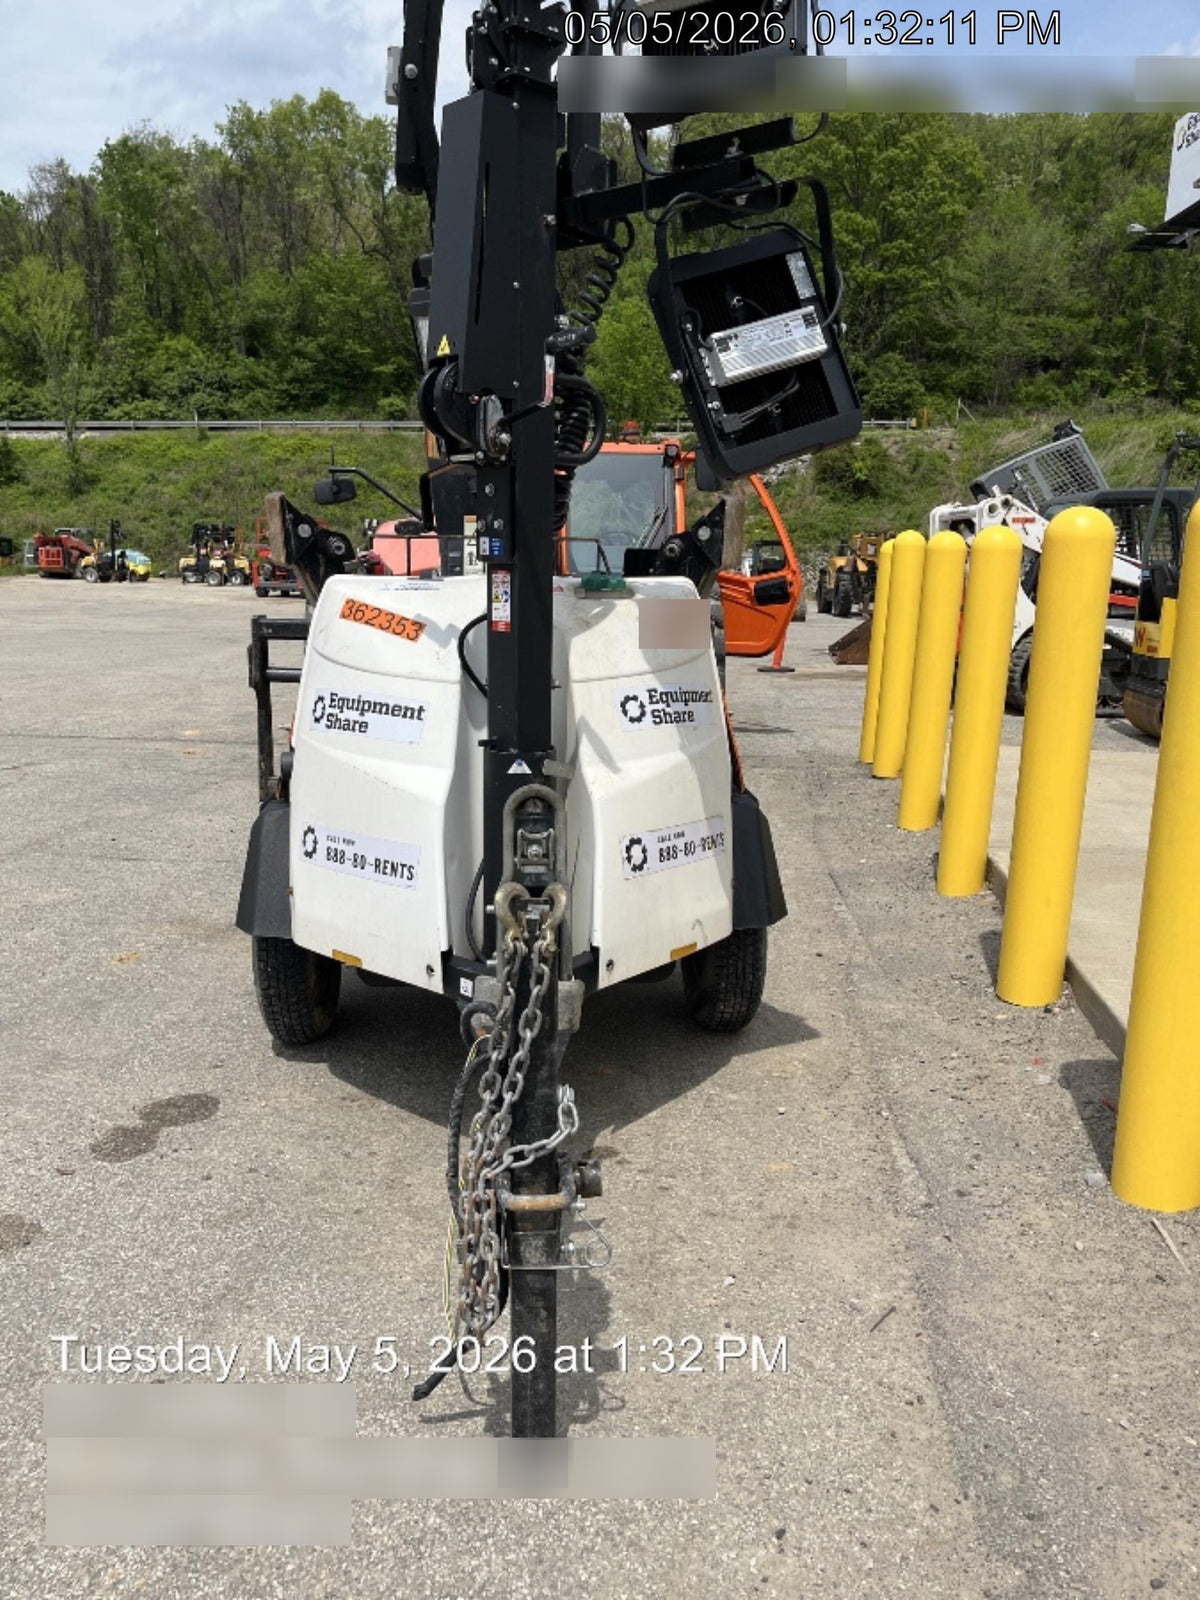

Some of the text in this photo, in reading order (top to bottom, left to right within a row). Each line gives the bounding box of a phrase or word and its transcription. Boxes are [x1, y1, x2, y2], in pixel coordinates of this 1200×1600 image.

[342, 599, 425, 641] 362353
[328, 692, 426, 721] Equipment
[651, 708, 695, 725] Share
[325, 713, 369, 734] Share
[326, 846, 415, 881] 888-80-RENTS
